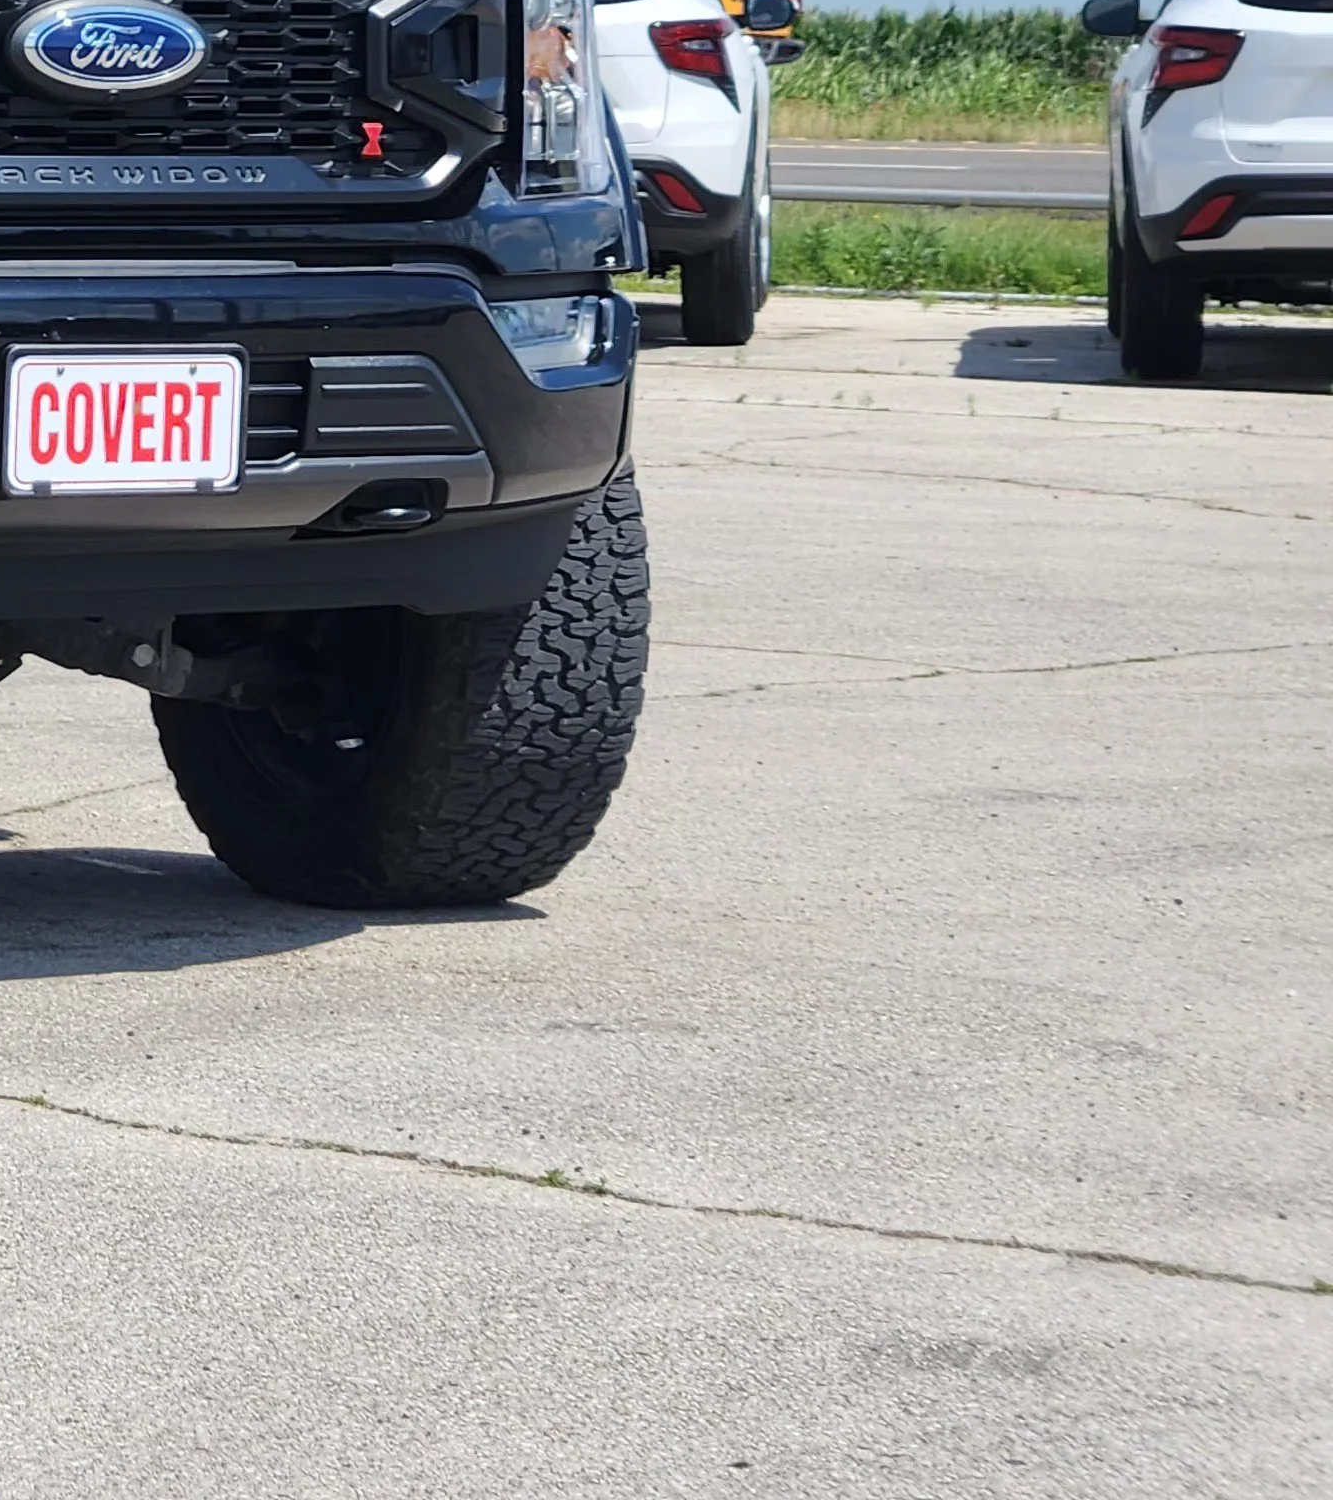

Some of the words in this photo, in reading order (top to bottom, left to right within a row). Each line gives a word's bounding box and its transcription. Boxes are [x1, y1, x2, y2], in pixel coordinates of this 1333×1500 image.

[70, 21, 167, 70] Ford
[111, 165, 267, 185] WIDOW
[30, 381, 222, 465] COVERT
